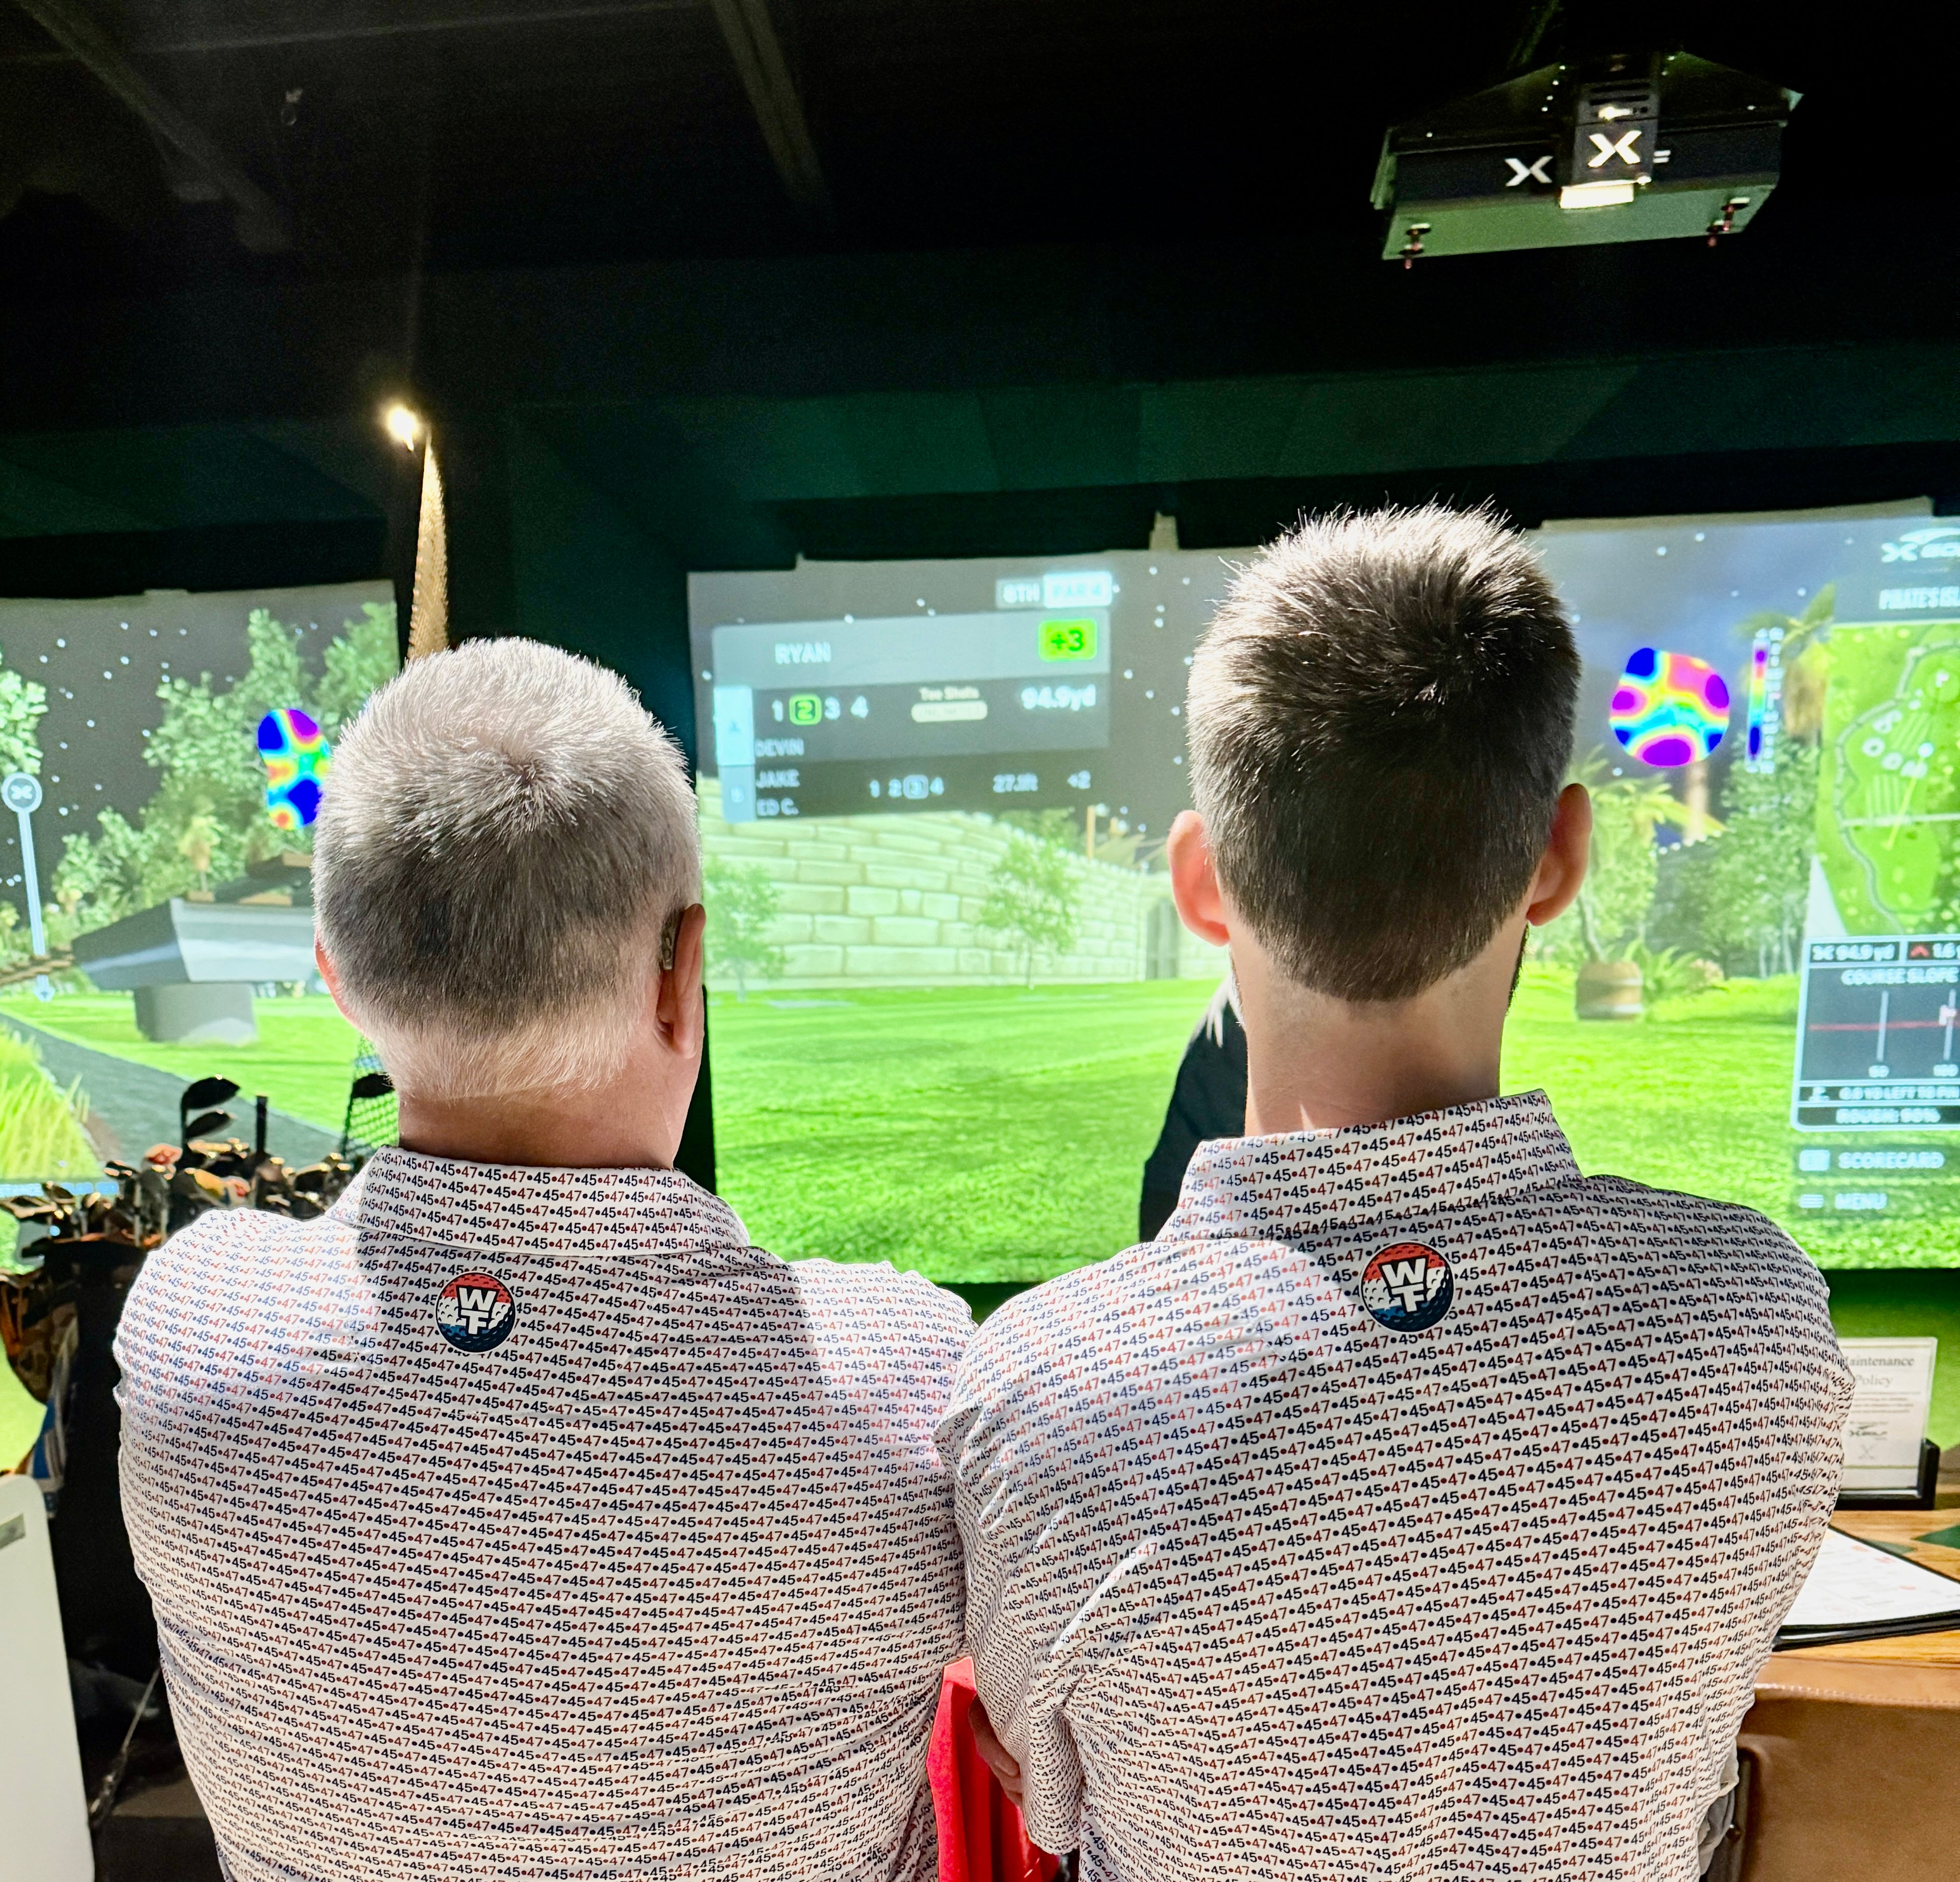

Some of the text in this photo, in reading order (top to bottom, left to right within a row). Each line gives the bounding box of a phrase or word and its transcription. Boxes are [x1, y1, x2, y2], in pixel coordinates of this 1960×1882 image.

[1050, 628, 1085, 652] +3
[775, 641, 831, 664] RYAN
[771, 695, 869, 722] 1 2 3 4
[1021, 684, 1096, 711] 94.9yd
[754, 738, 804, 757] DEVIN
[756, 769, 801, 789] JAKE
[869, 780, 880, 798] 1
[929, 776, 945, 796] 4
[756, 798, 780, 816] ED
[1839, 1151, 1945, 1169] SCORECARD
